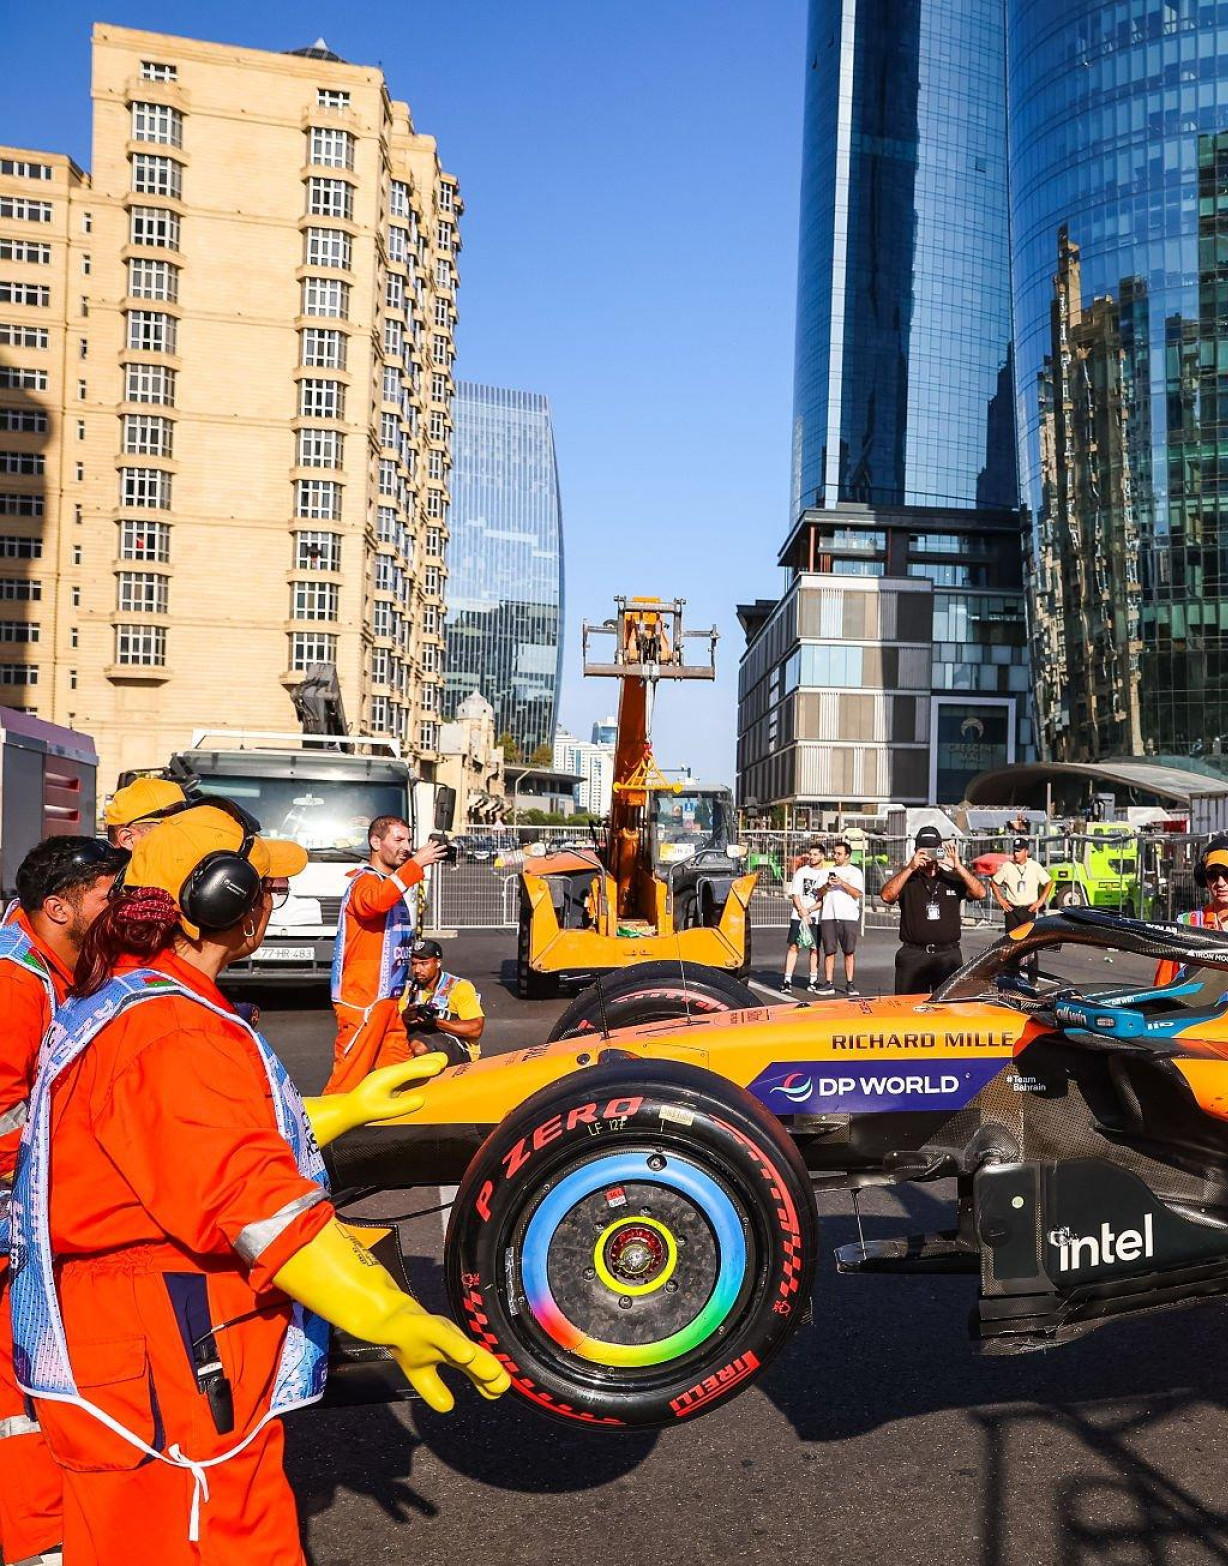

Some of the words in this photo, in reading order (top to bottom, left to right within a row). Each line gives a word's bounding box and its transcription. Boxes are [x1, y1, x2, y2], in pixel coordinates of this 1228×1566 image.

[1196, 951, 1214, 960] IRON
[832, 1034, 936, 1050] RICHARD
[944, 1031, 1013, 1047] MILLE
[819, 1077, 856, 1097] DP
[860, 1075, 959, 1095] WORLD
[1013, 1082, 1047, 1092] Bahrain
[475, 1180, 494, 1223] P
[502, 1096, 643, 1178] ZERO
[1058, 1212, 1155, 1271] intel
[669, 1350, 761, 1417] PIRELLI
